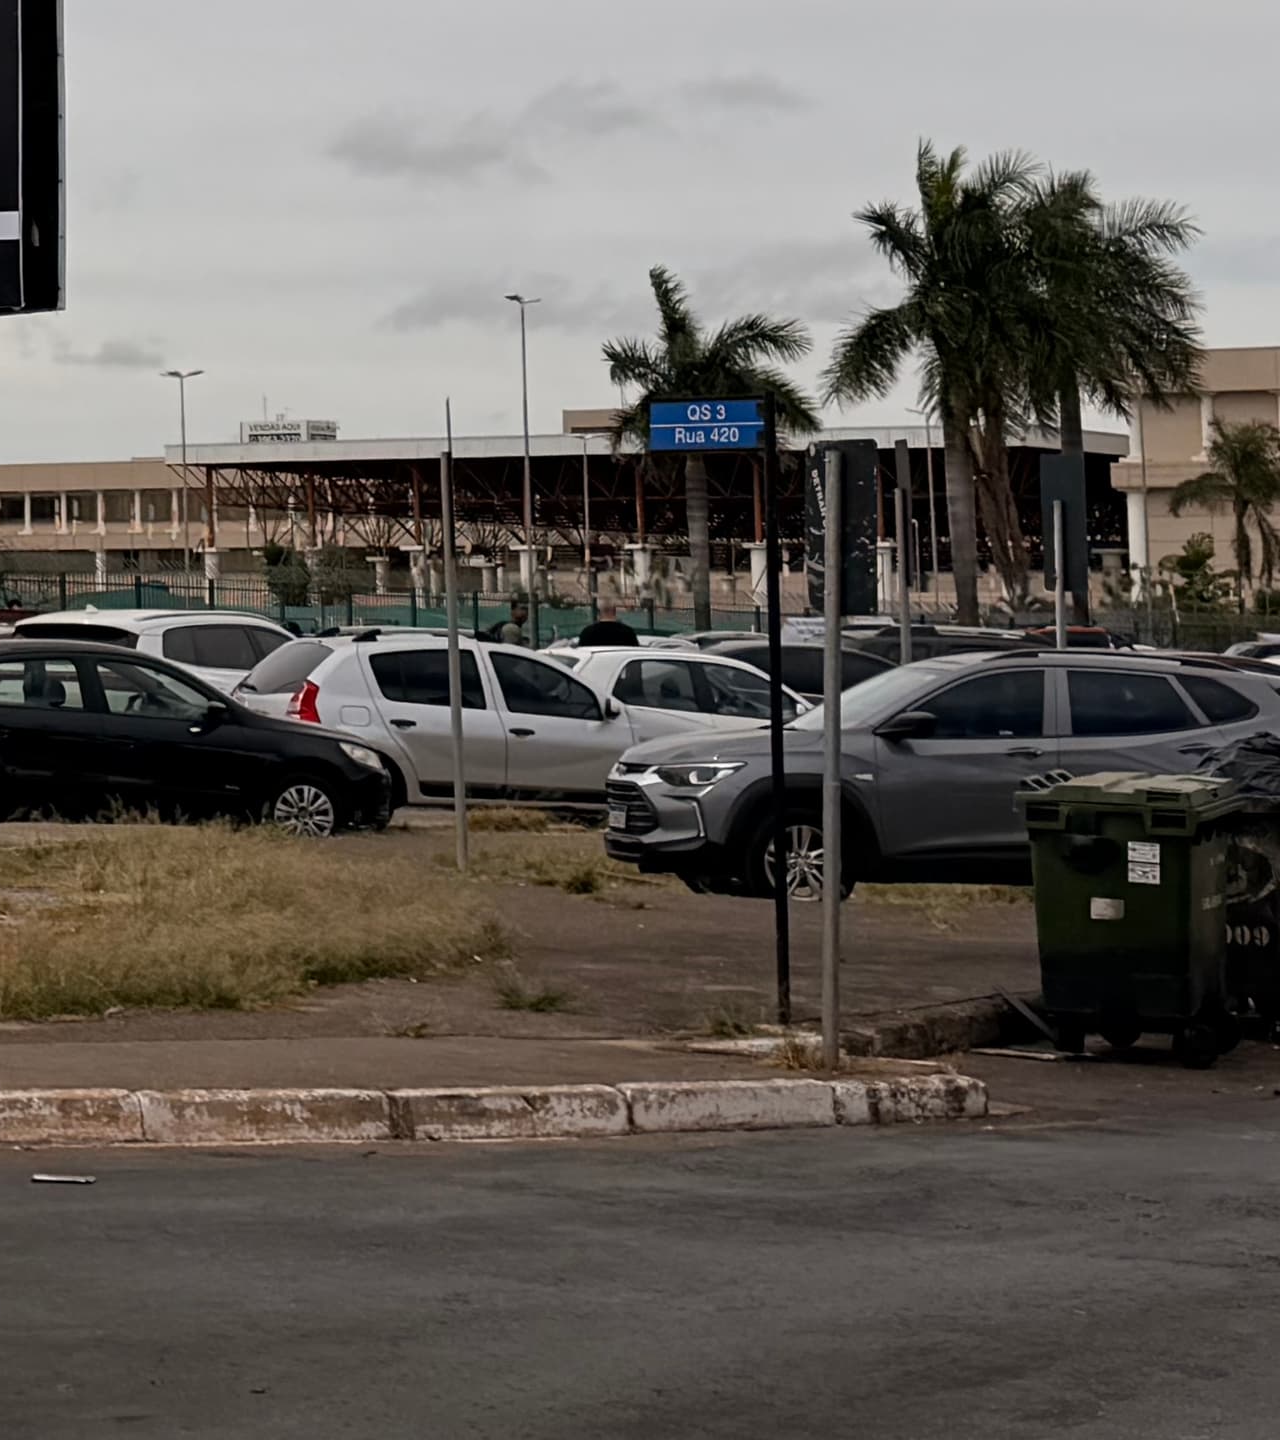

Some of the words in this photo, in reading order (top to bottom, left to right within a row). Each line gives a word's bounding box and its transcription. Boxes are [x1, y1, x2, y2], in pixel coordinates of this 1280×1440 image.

[687, 404, 711, 421] QS
[716, 404, 726, 420] 3
[675, 427, 705, 444] Rua
[710, 427, 739, 442] 420
